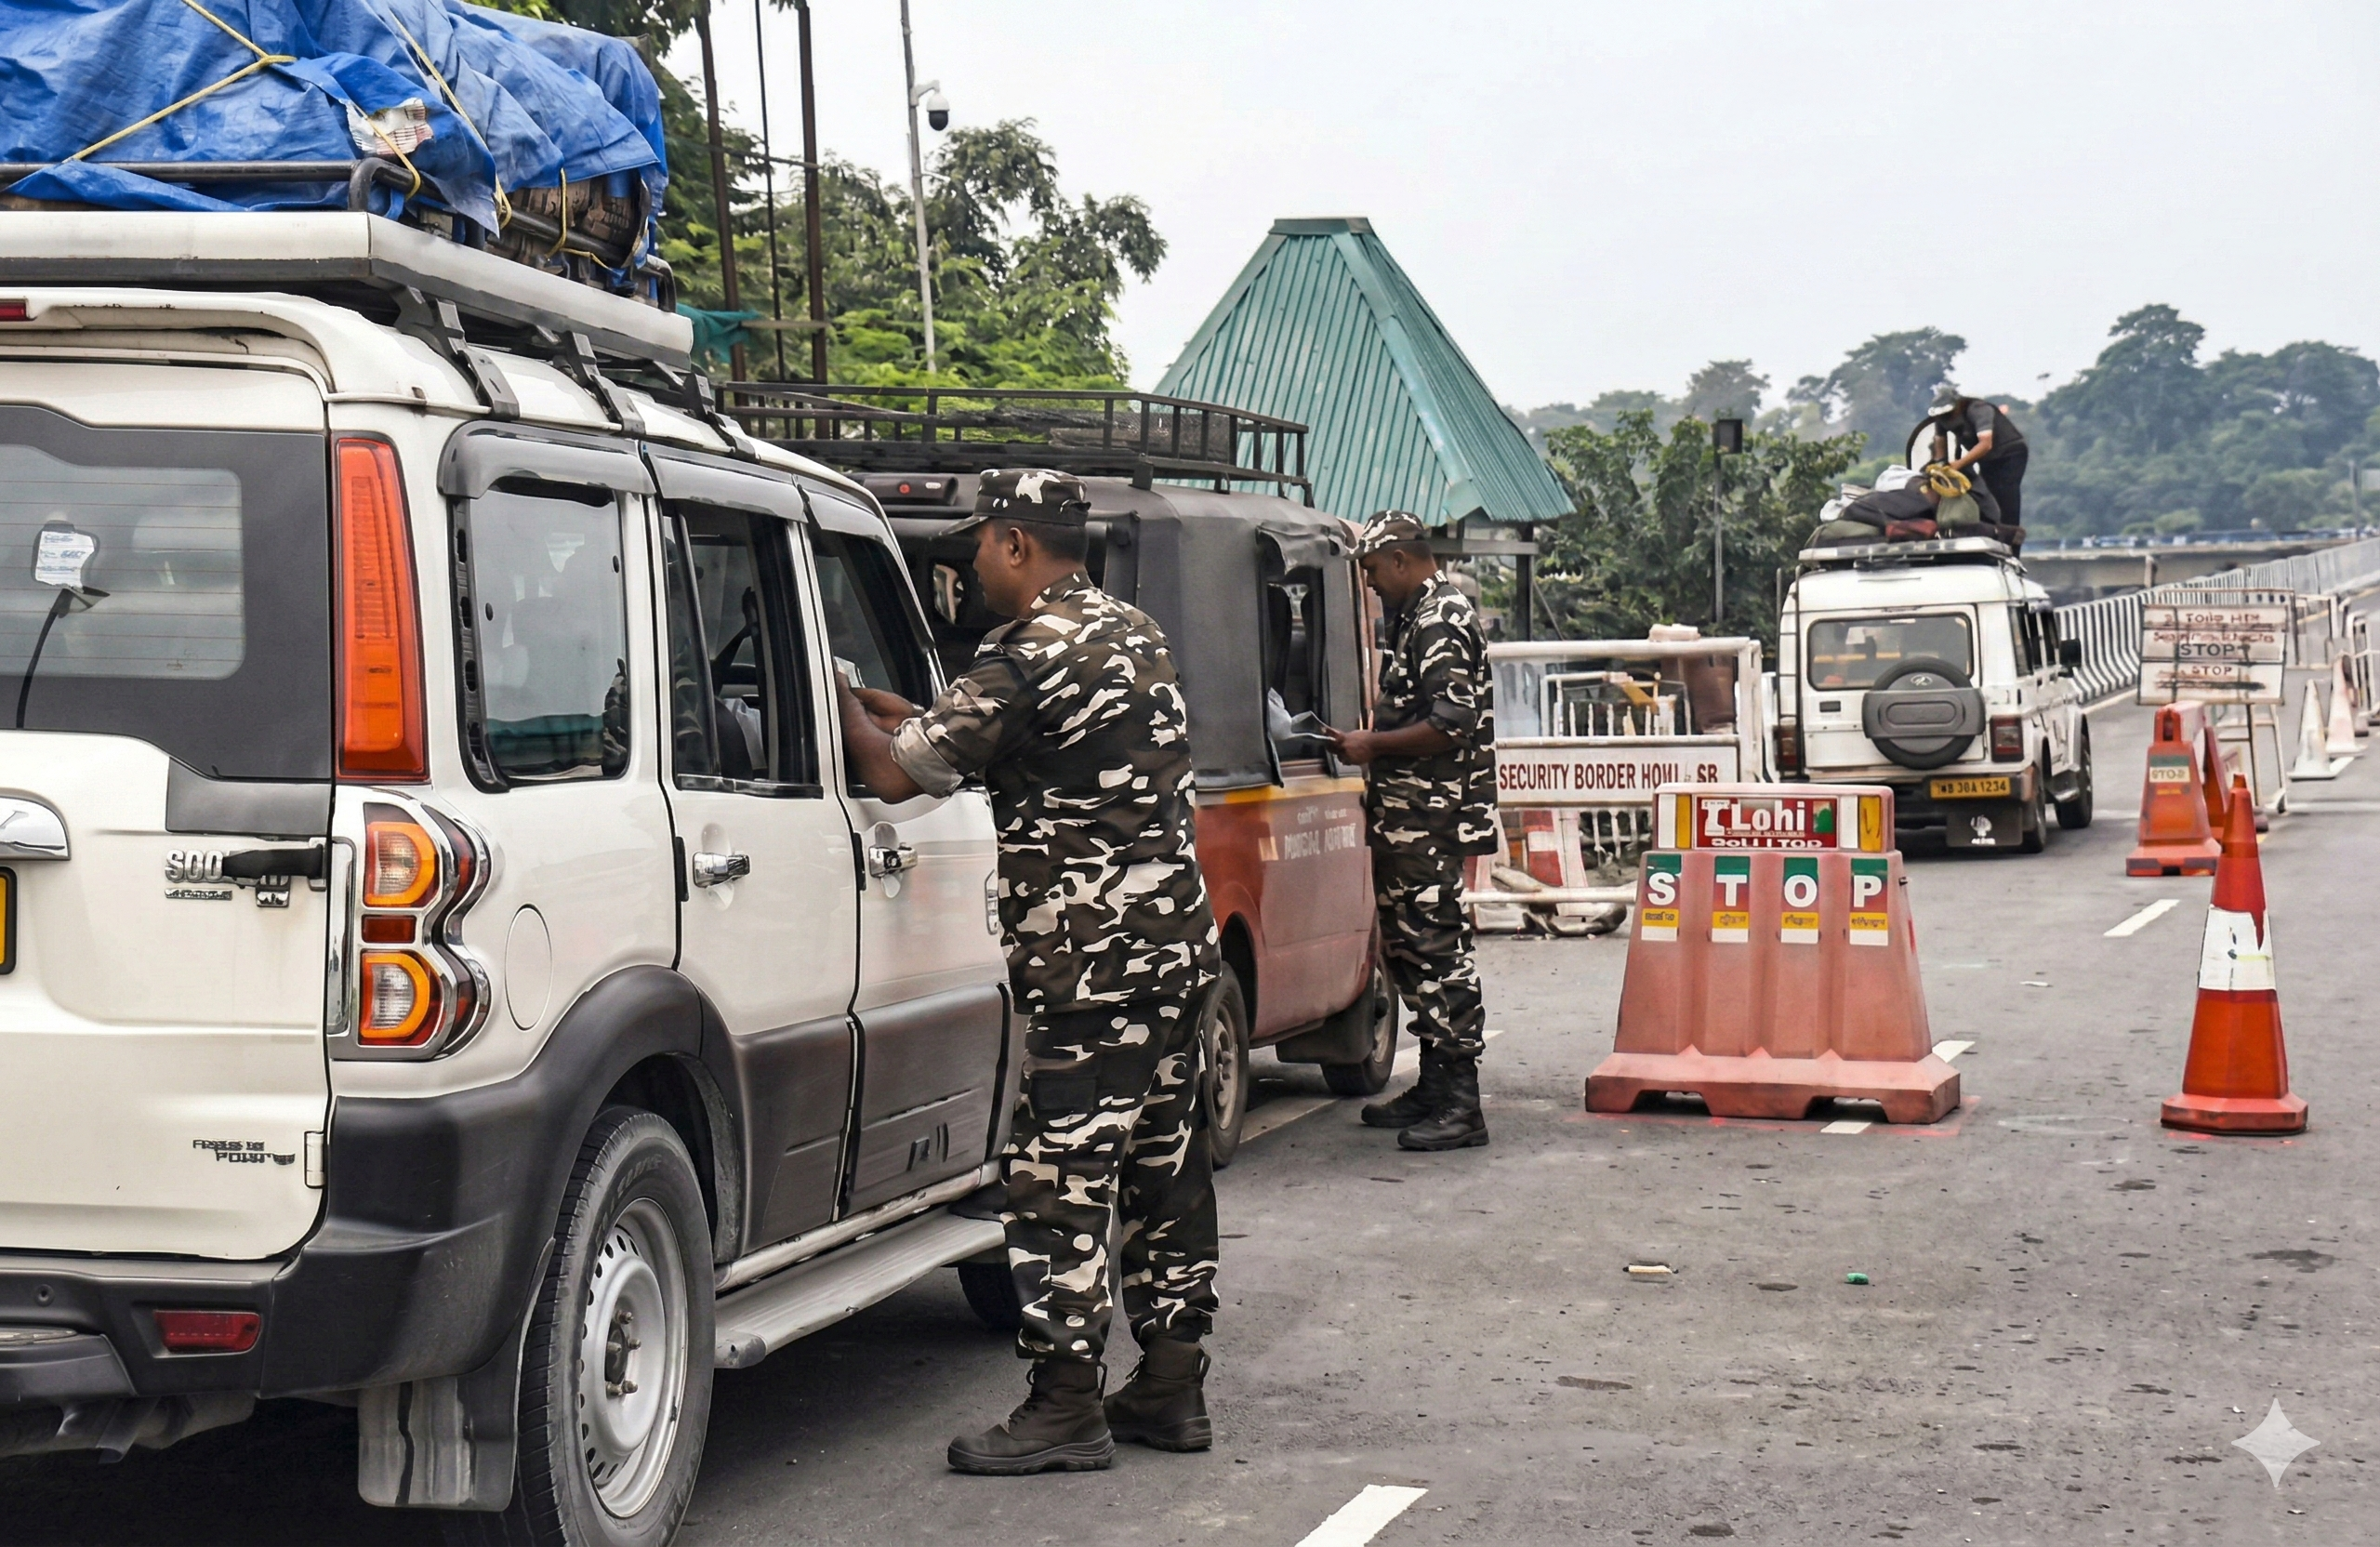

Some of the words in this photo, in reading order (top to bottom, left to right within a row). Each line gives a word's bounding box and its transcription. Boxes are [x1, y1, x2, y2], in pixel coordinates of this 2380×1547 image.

[2180, 643, 2235, 656] STOP
[2192, 666, 2232, 675] STOP
[1499, 763, 1569, 790] SECURITY
[1575, 763, 1636, 790] BORDER
[1980, 781, 2006, 792] 1234
